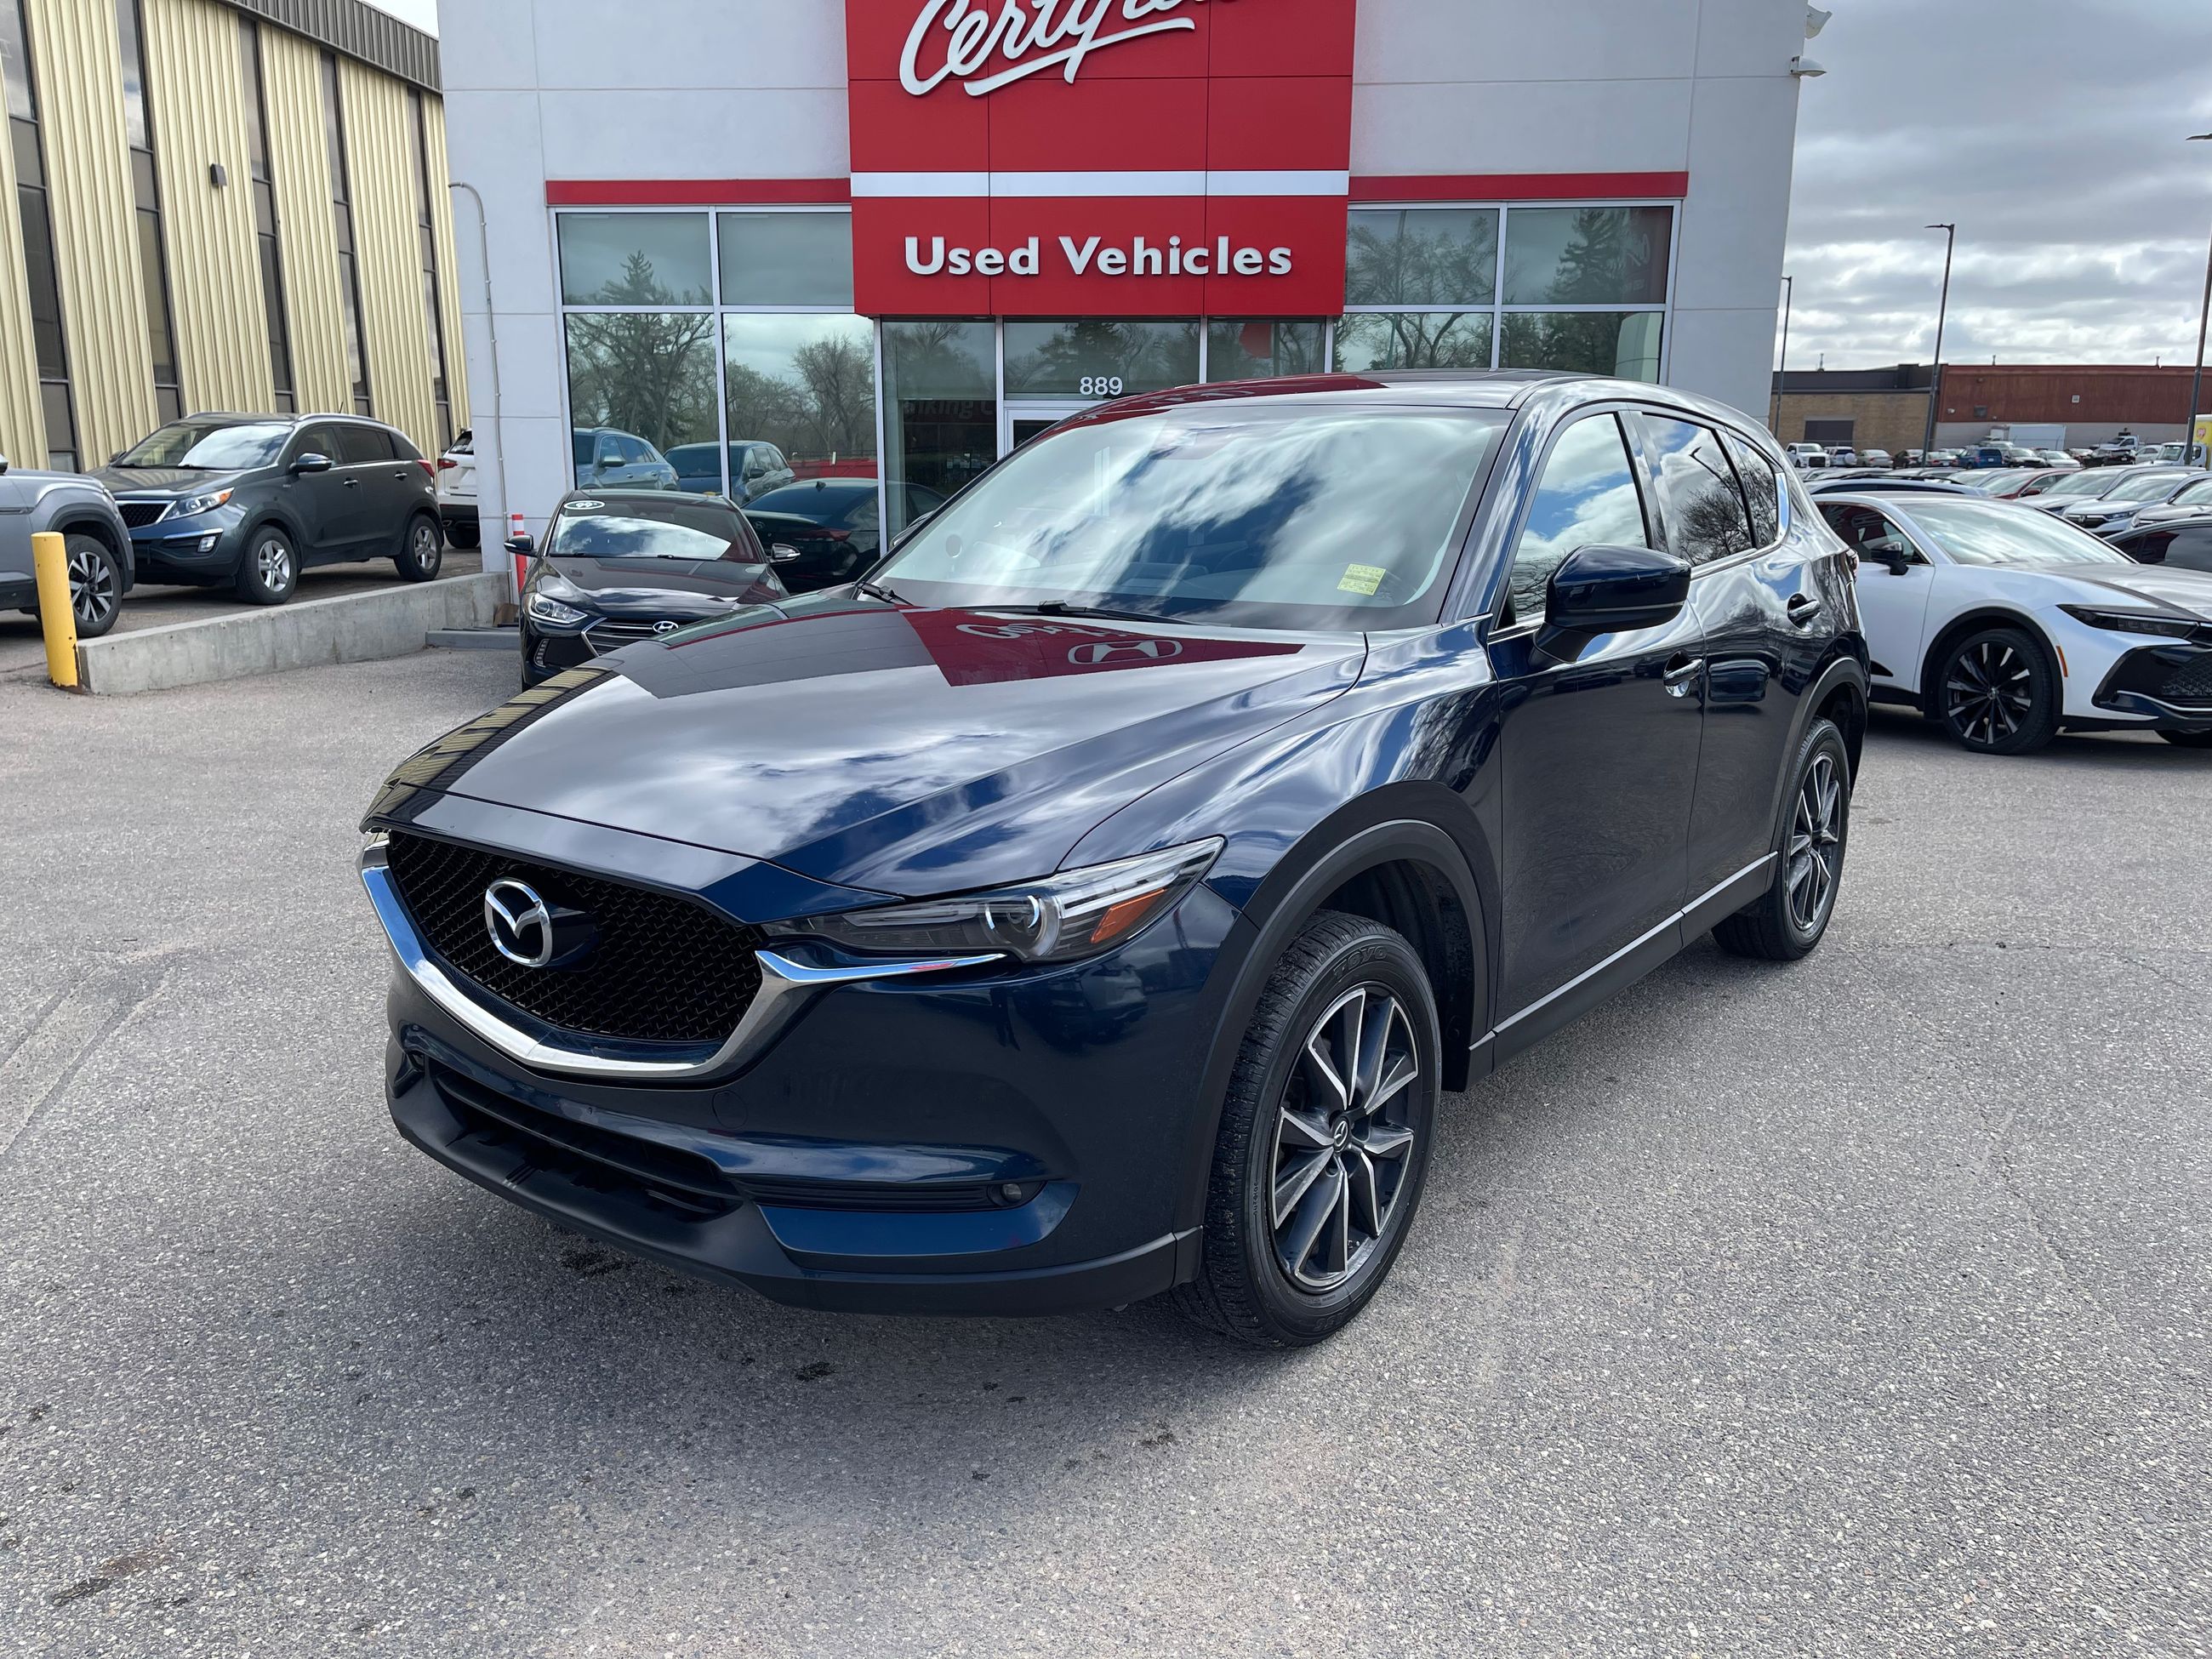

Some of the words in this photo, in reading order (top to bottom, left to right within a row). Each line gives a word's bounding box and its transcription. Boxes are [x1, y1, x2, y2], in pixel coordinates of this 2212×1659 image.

[904, 236, 1040, 276] Used
[1058, 235, 1293, 276] Vehicles
[1079, 376, 1123, 396] 889
